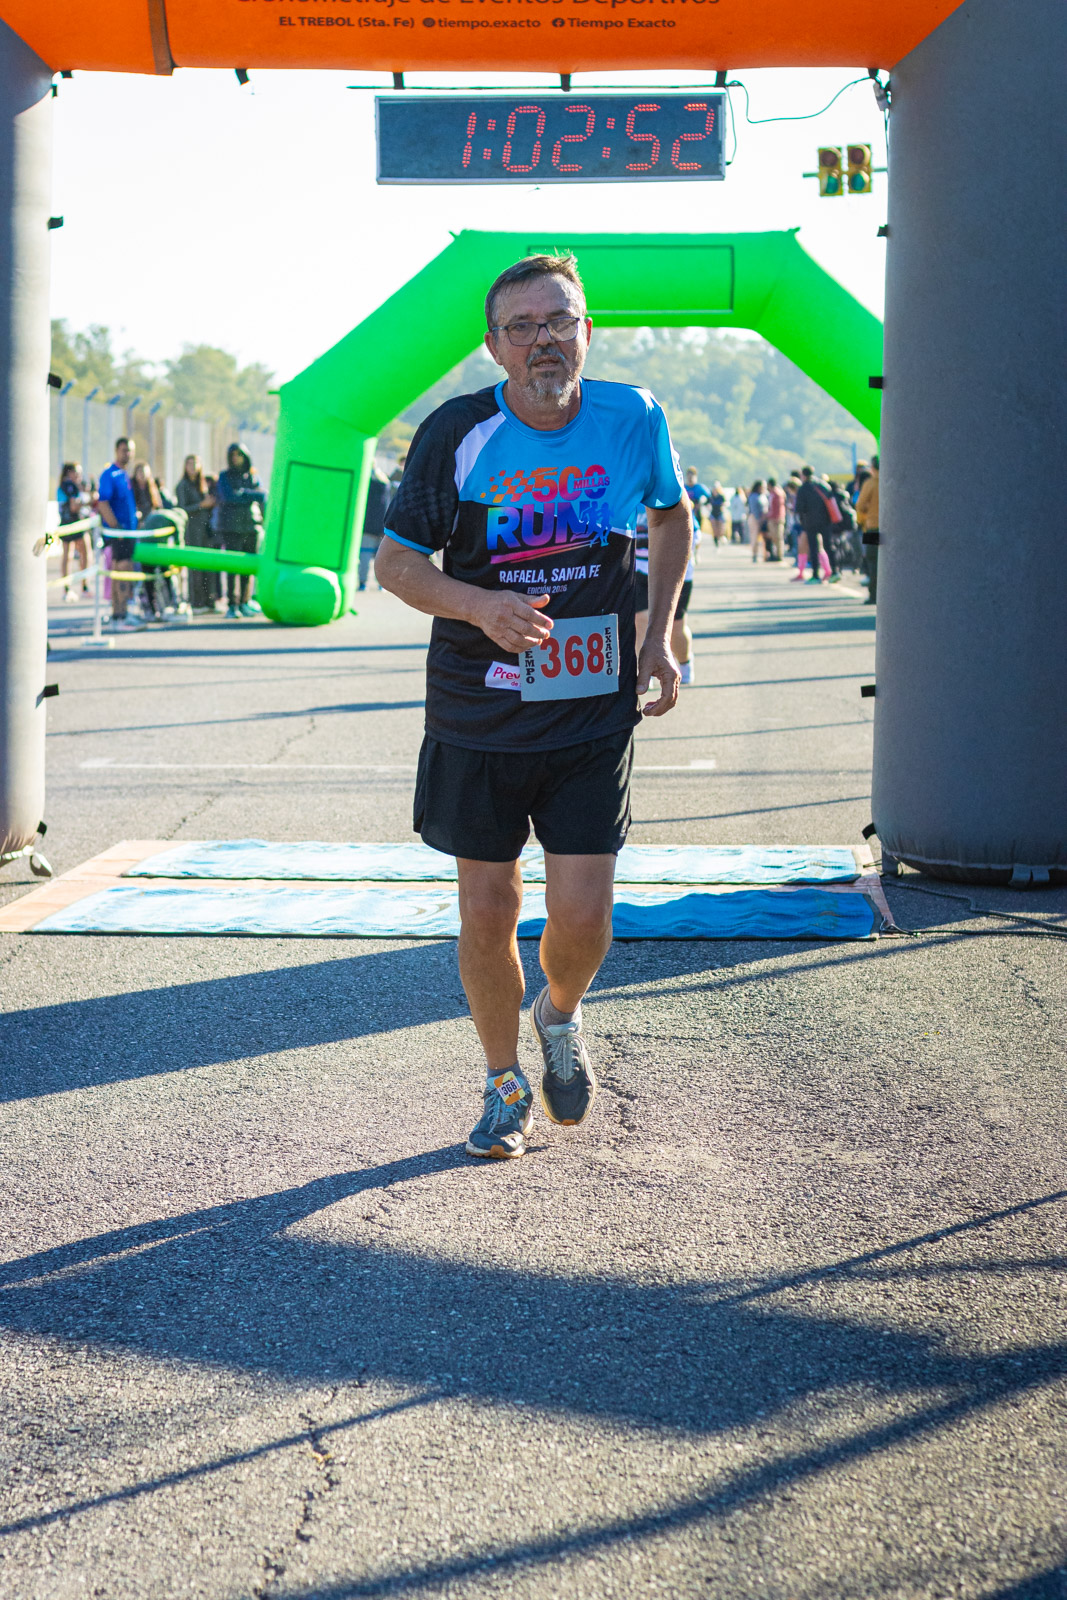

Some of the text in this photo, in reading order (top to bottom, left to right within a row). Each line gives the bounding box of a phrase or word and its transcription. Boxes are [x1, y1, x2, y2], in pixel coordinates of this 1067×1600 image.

[279, 16, 415, 28] EL TREBOL (Sta. Fe)
[438, 18, 541, 30] tiempo.exacto
[567, 17, 676, 30] Tiempo Exacto
[462, 103, 715, 173] 1:02:52
[573, 476, 610, 490] MILLAS
[499, 564, 601, 584] RAFAELA, SANTA FE
[526, 584, 551, 595] EDICIÓN
[540, 633, 605, 678] 368
[604, 627, 614, 676] EXACTO
[501, 1081, 517, 1095] 368
